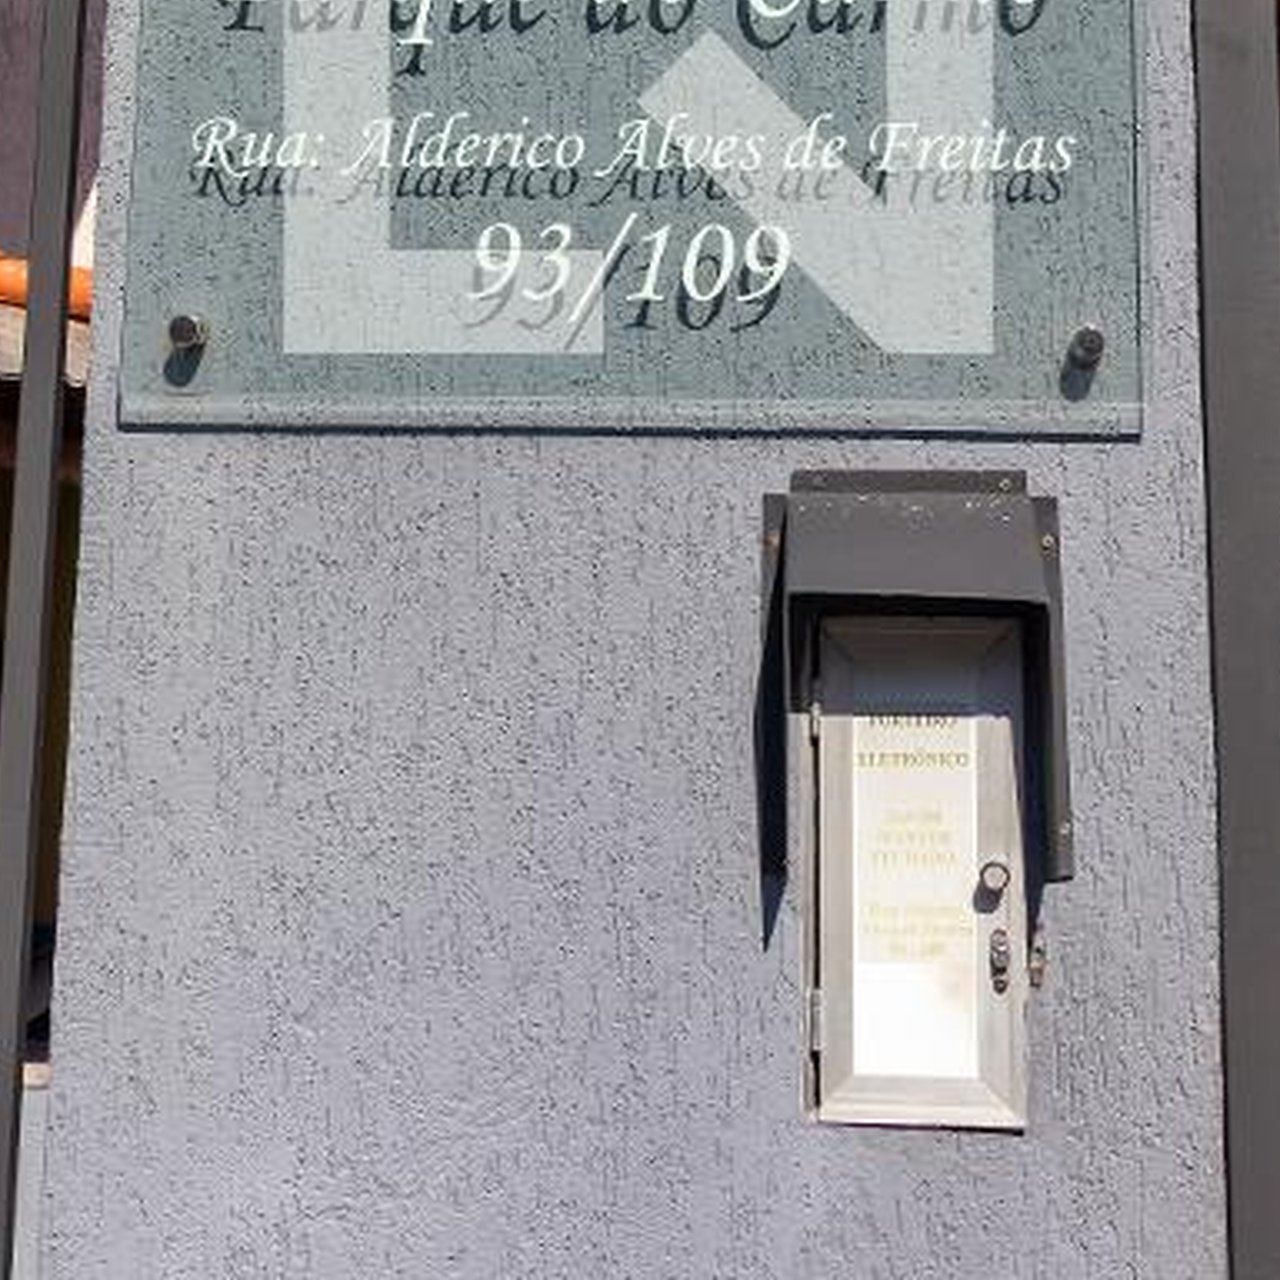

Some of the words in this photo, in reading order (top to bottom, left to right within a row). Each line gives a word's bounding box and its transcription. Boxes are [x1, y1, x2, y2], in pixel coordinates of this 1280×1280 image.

[192, 117, 325, 178] Rua:
[340, 112, 586, 176] Alderico
[595, 113, 767, 178] Alves
[784, 113, 849, 172] de
[868, 118, 1078, 173] Freitas
[464, 212, 793, 328] 93/109
